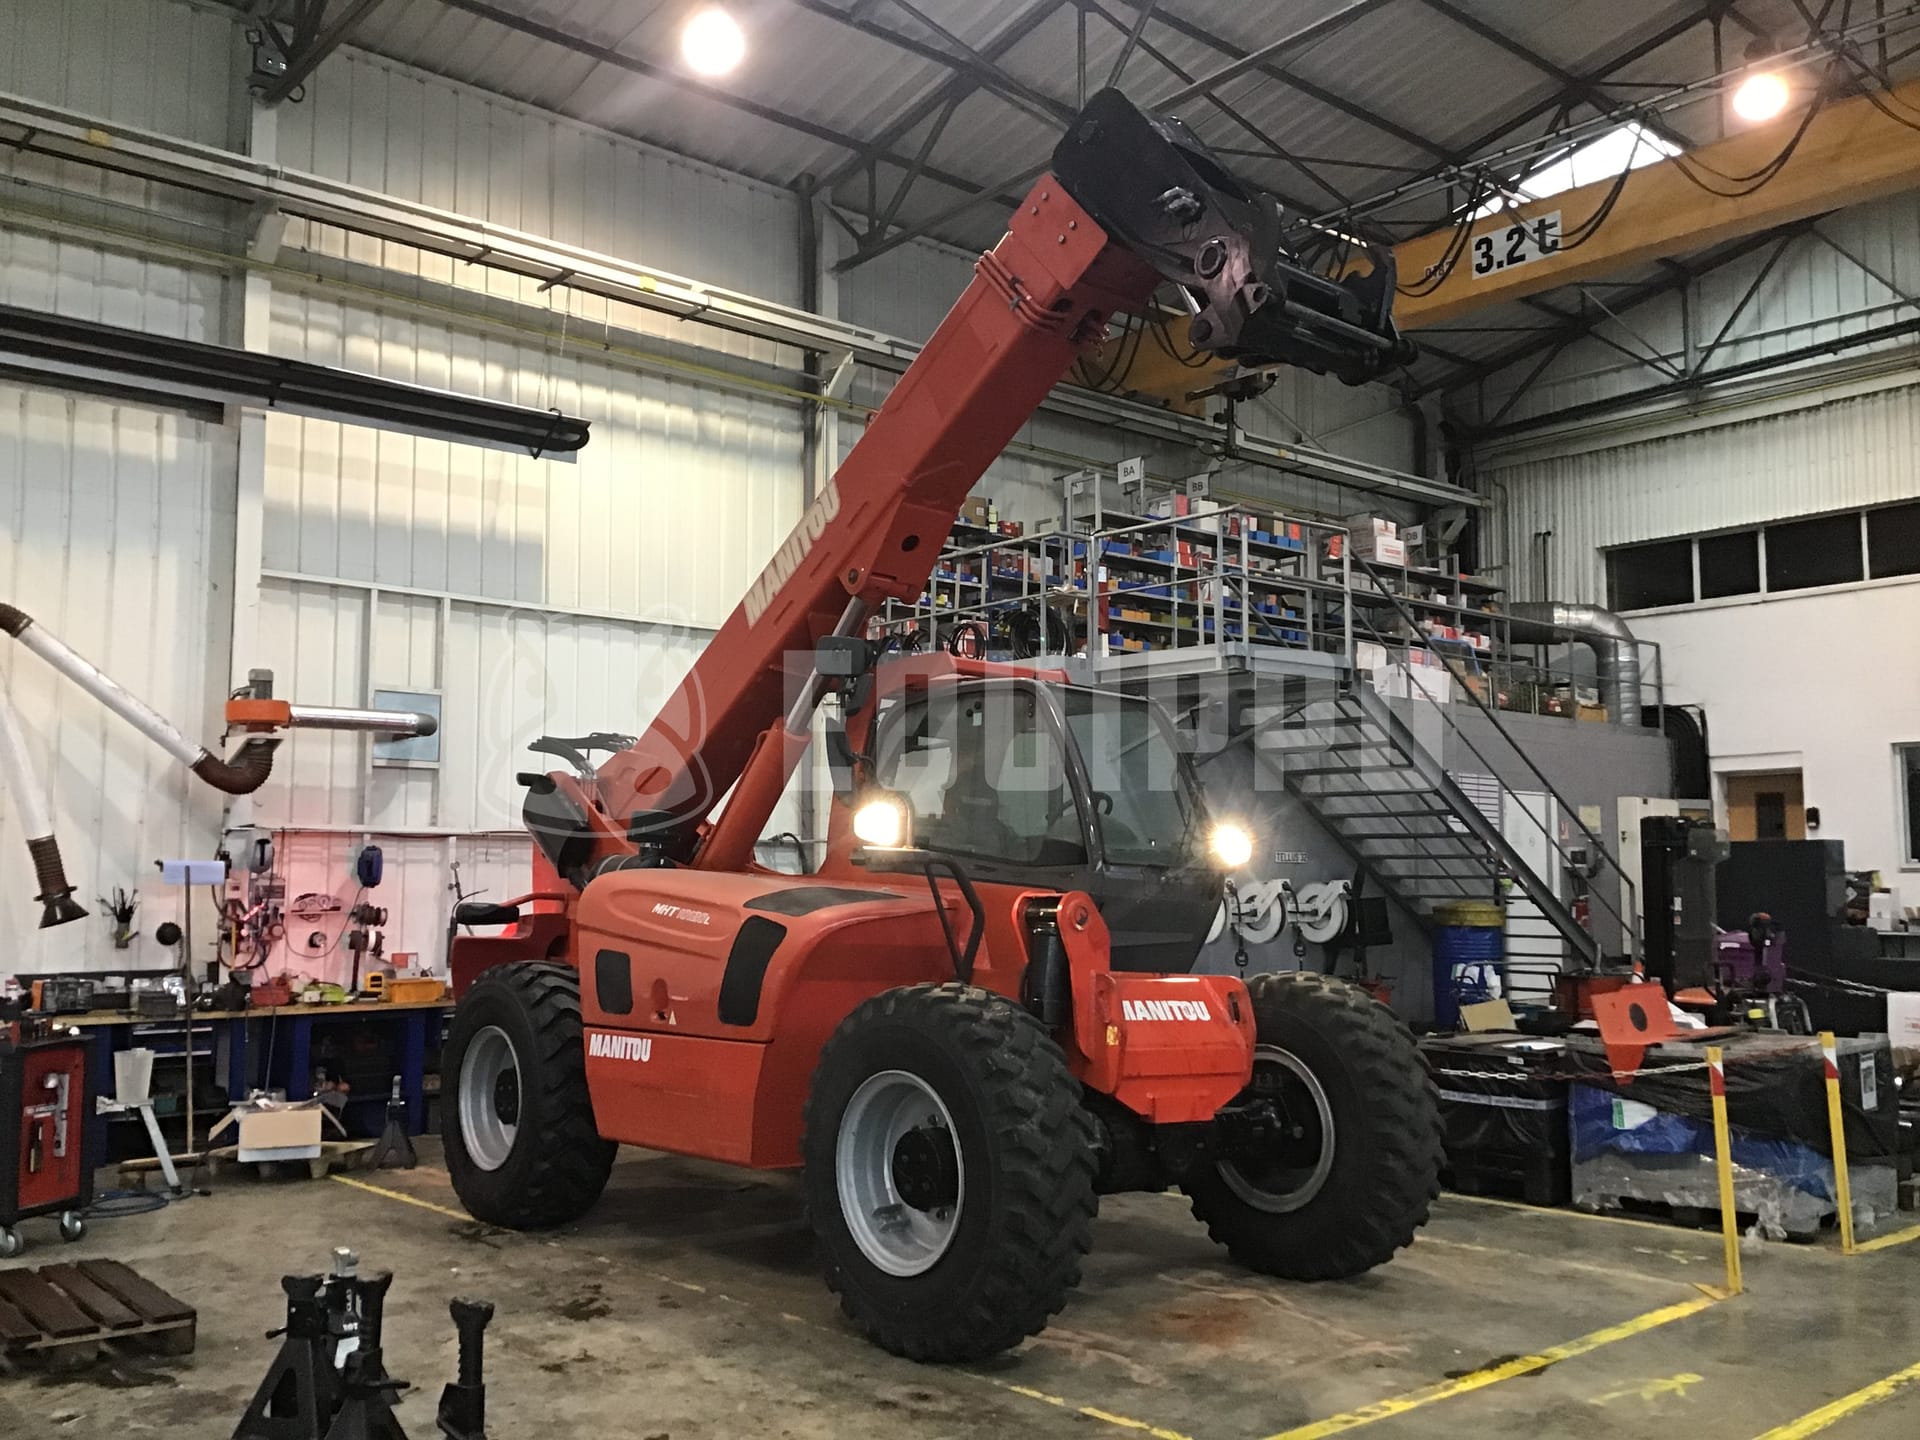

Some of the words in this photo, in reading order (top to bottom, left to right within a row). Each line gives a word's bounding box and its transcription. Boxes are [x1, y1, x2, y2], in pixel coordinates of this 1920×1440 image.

[1475, 226, 1526, 275] 3.2
[1533, 218, 1559, 255] t
[1123, 465, 1135, 477] BA
[1192, 481, 1204, 492] BB
[743, 476, 841, 630] MANITOU
[651, 903, 680, 917] MHT
[1122, 999, 1211, 1021] MANITOU
[589, 1033, 652, 1062] MANITOU
